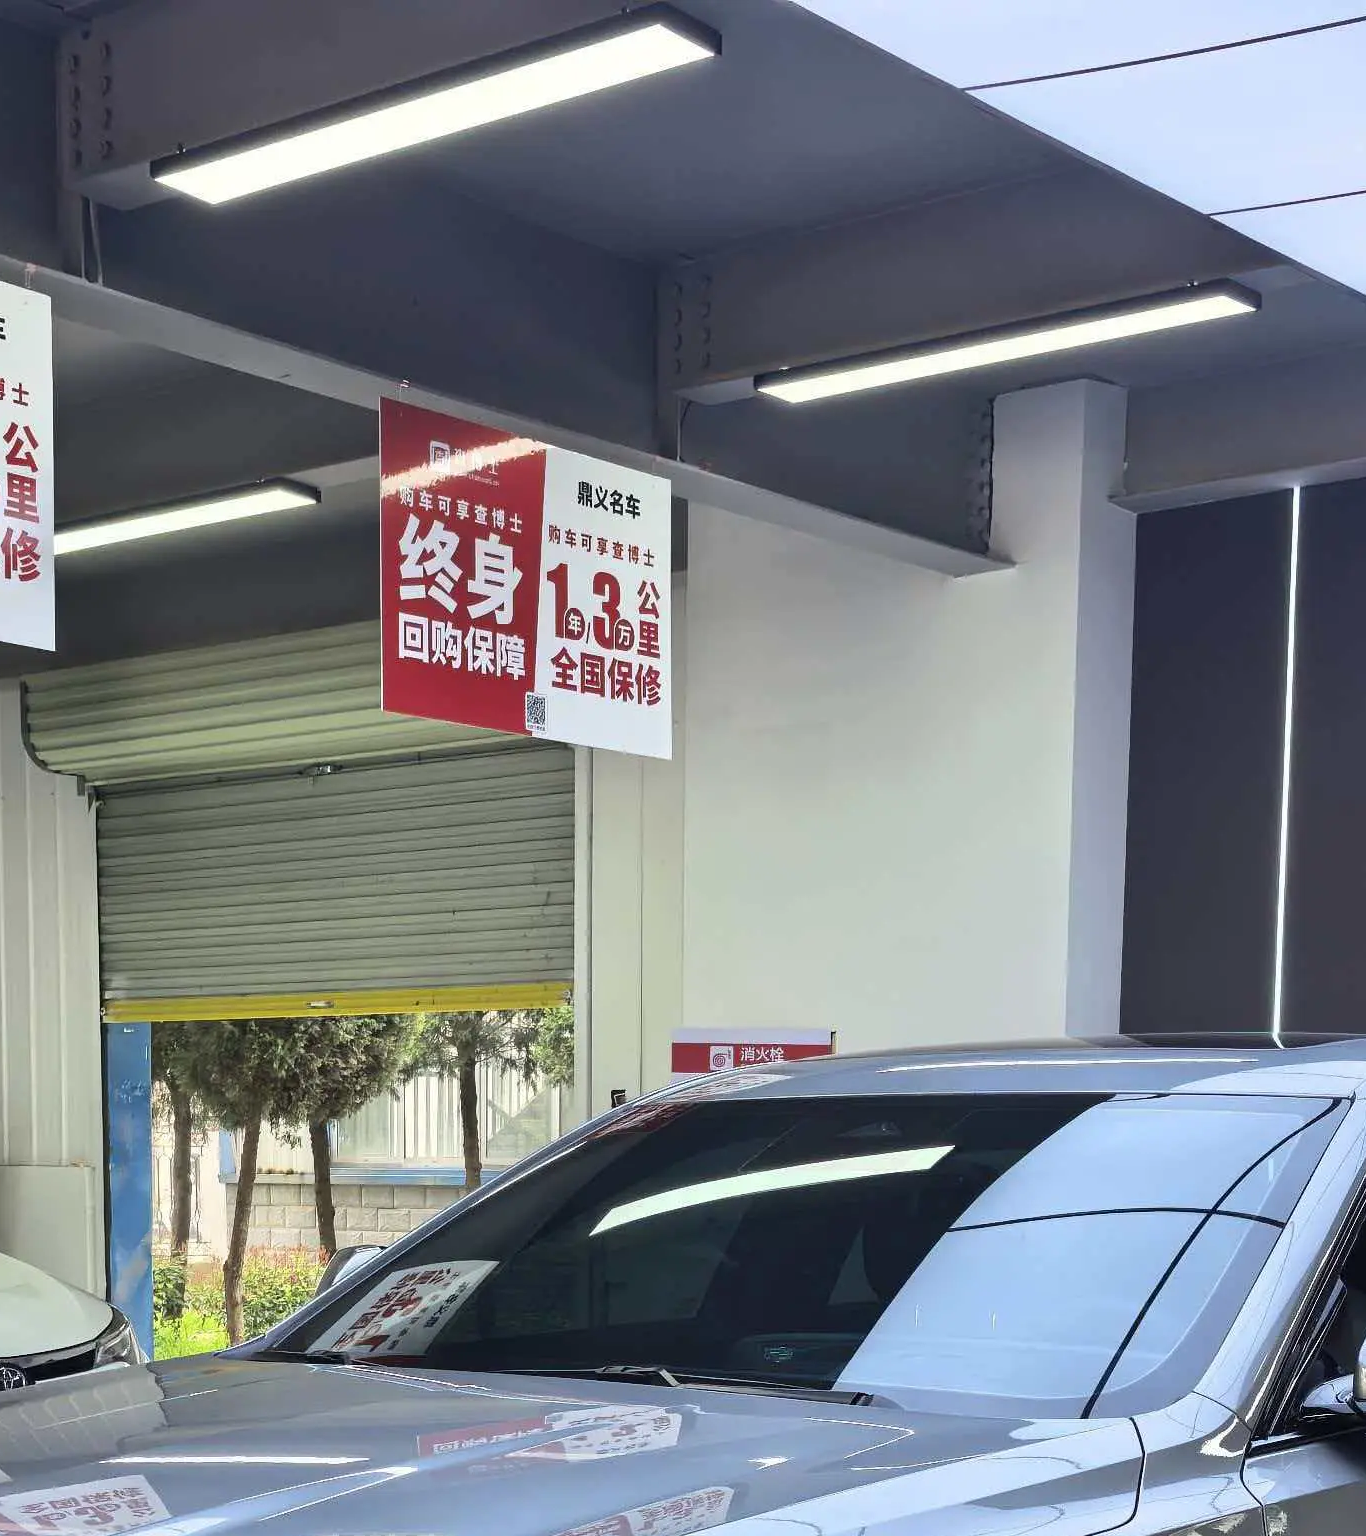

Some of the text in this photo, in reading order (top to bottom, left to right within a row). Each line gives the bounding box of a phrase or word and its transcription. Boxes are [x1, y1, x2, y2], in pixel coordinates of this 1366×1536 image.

[399, 486, 523, 534] 购车可享查博士
[577, 480, 641, 520] 鼎义名车
[398, 513, 523, 625] 终身
[548, 524, 656, 569] 购车可享查博士
[398, 611, 526, 681] 回购保障
[551, 646, 662, 706] 全国保修
[740, 1046, 785, 1062] 消火栓
